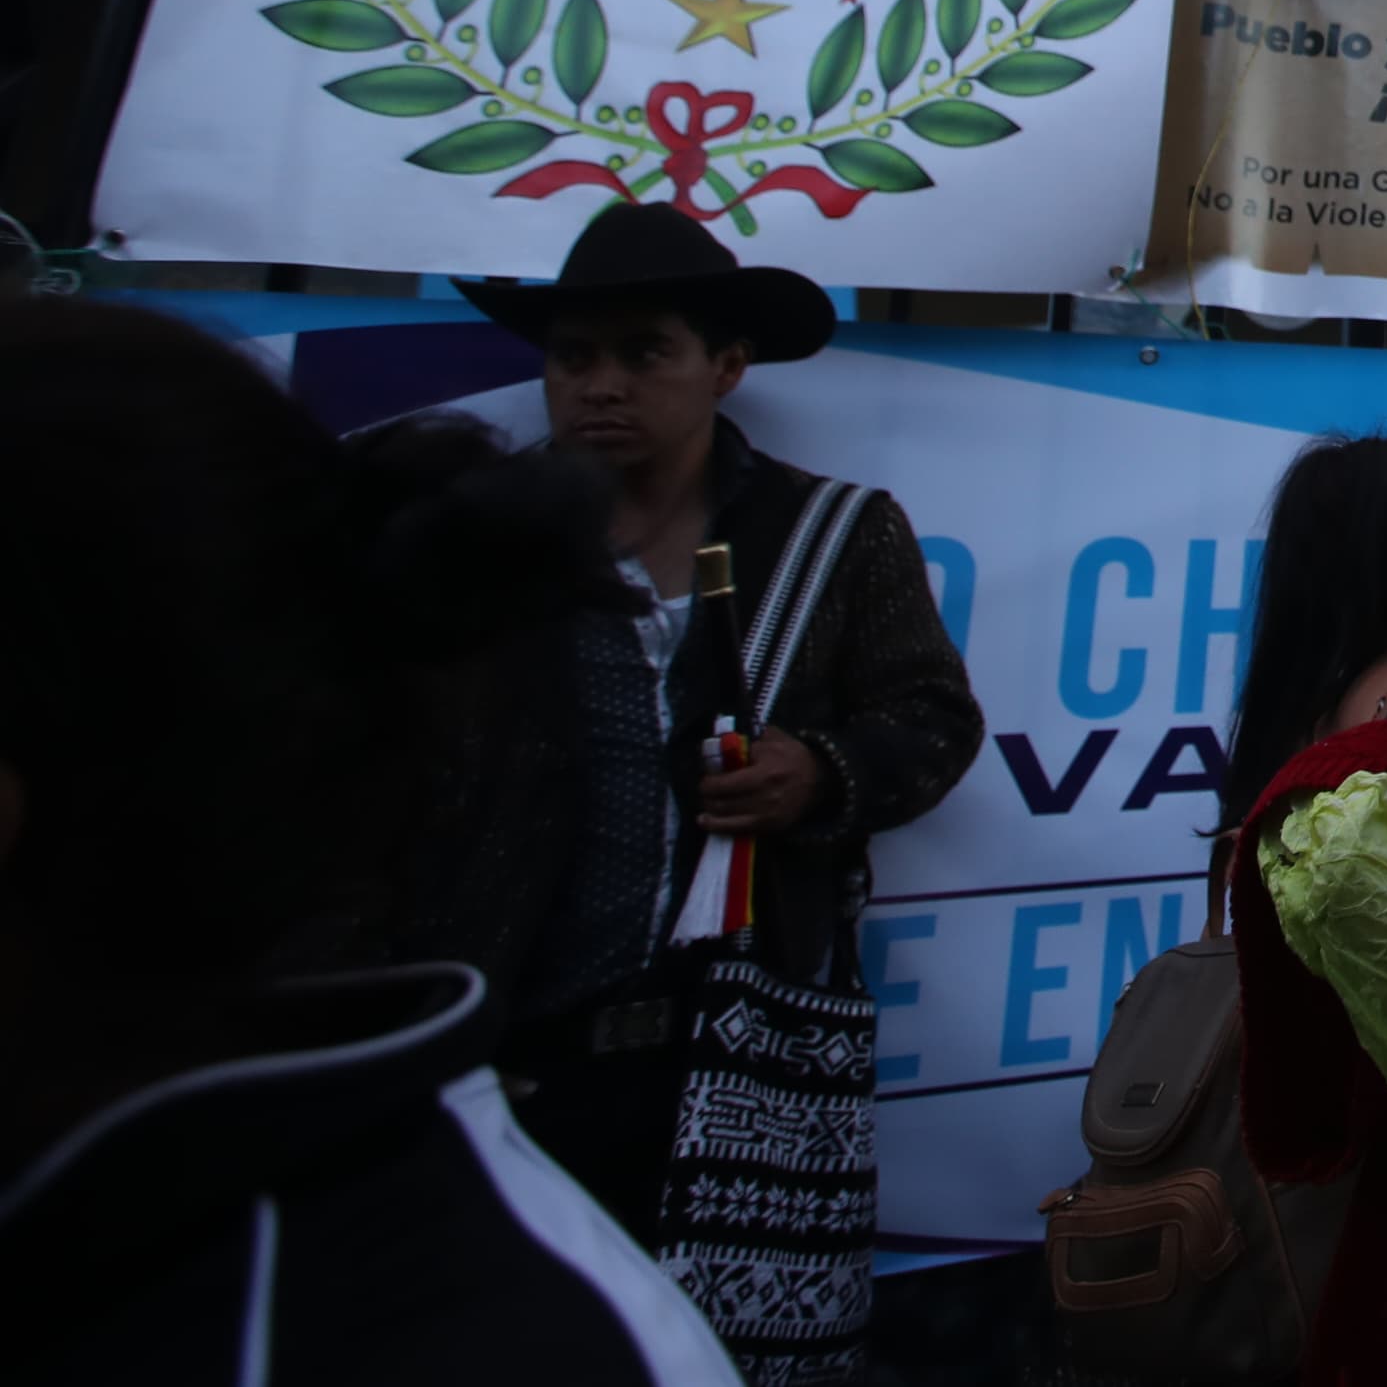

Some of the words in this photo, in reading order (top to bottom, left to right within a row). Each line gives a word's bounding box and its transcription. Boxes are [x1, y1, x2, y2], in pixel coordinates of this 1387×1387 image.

[1201, 2, 1373, 60] Pueblo
[1242, 156, 1293, 185] Por
[1302, 169, 1360, 191] una
[1187, 185, 1234, 213] No
[1268, 197, 1293, 225] la
